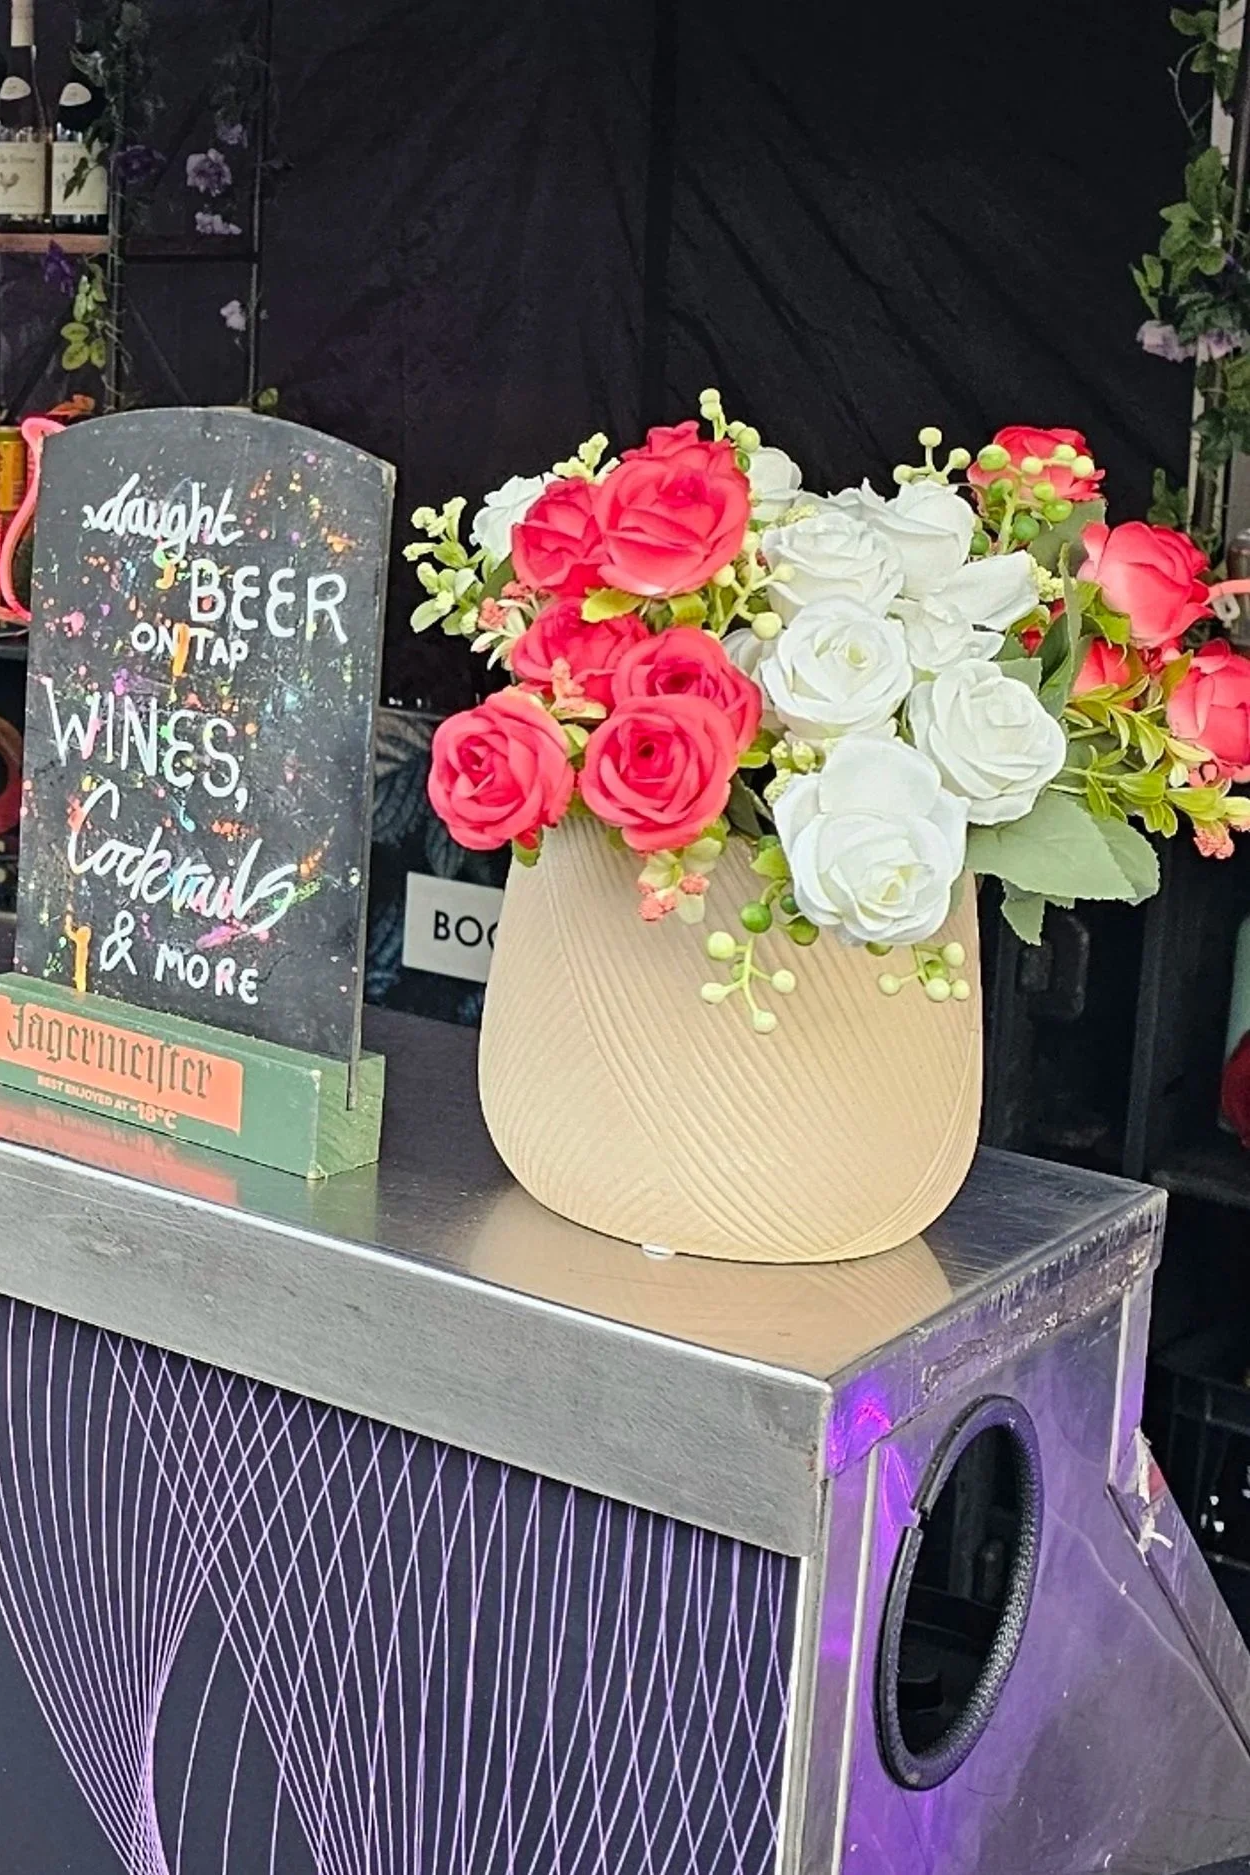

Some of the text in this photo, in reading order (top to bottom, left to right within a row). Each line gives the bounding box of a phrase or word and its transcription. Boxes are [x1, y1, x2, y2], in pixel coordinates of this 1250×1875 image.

[190, 559, 348, 644] BEER
[189, 627, 249, 671] TAP
[100, 909, 260, 1005] & MORE
[37, 1074, 64, 1092] BEST
[65, 1082, 113, 1106] ENJOYED
[113, 1100, 128, 1112] AT
